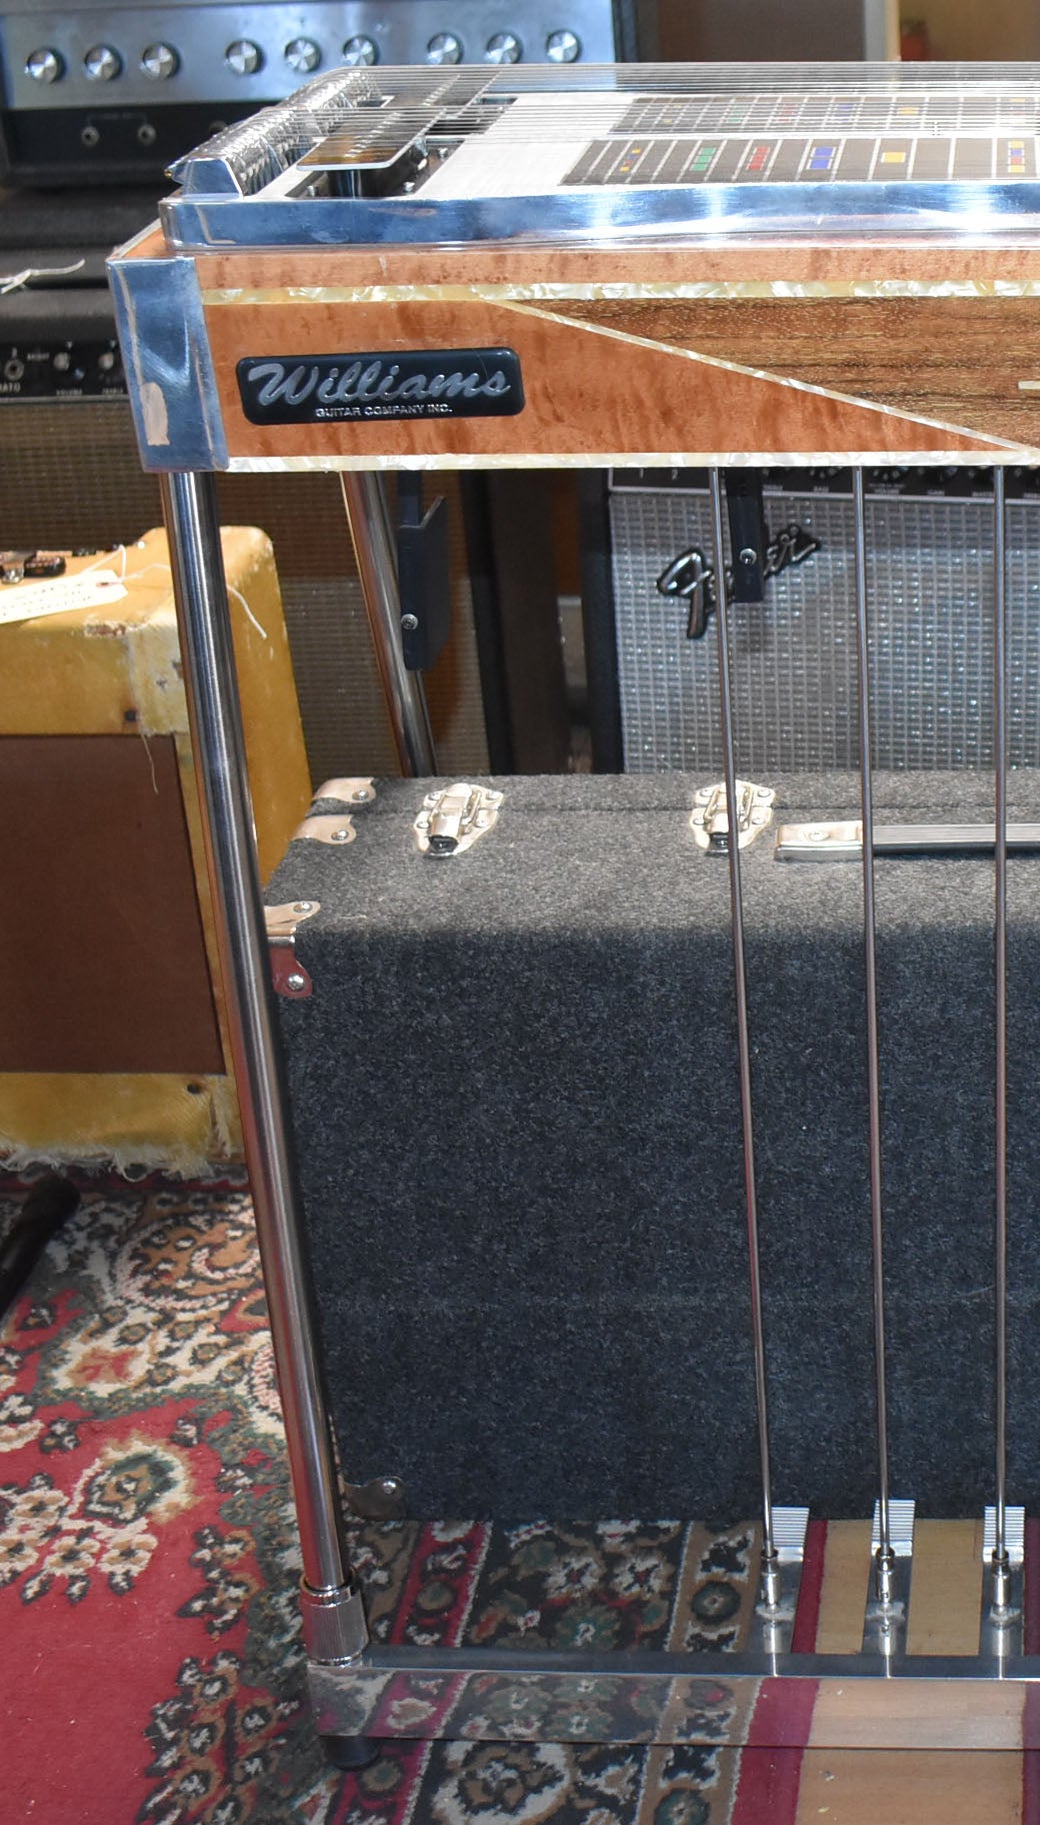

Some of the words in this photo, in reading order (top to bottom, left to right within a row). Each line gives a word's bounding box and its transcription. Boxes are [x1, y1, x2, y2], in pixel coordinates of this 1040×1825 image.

[248, 360, 511, 405] Williams
[315, 407, 361, 417] GUITAR
[364, 404, 424, 416] COMPANY
[427, 403, 453, 413] INC.
